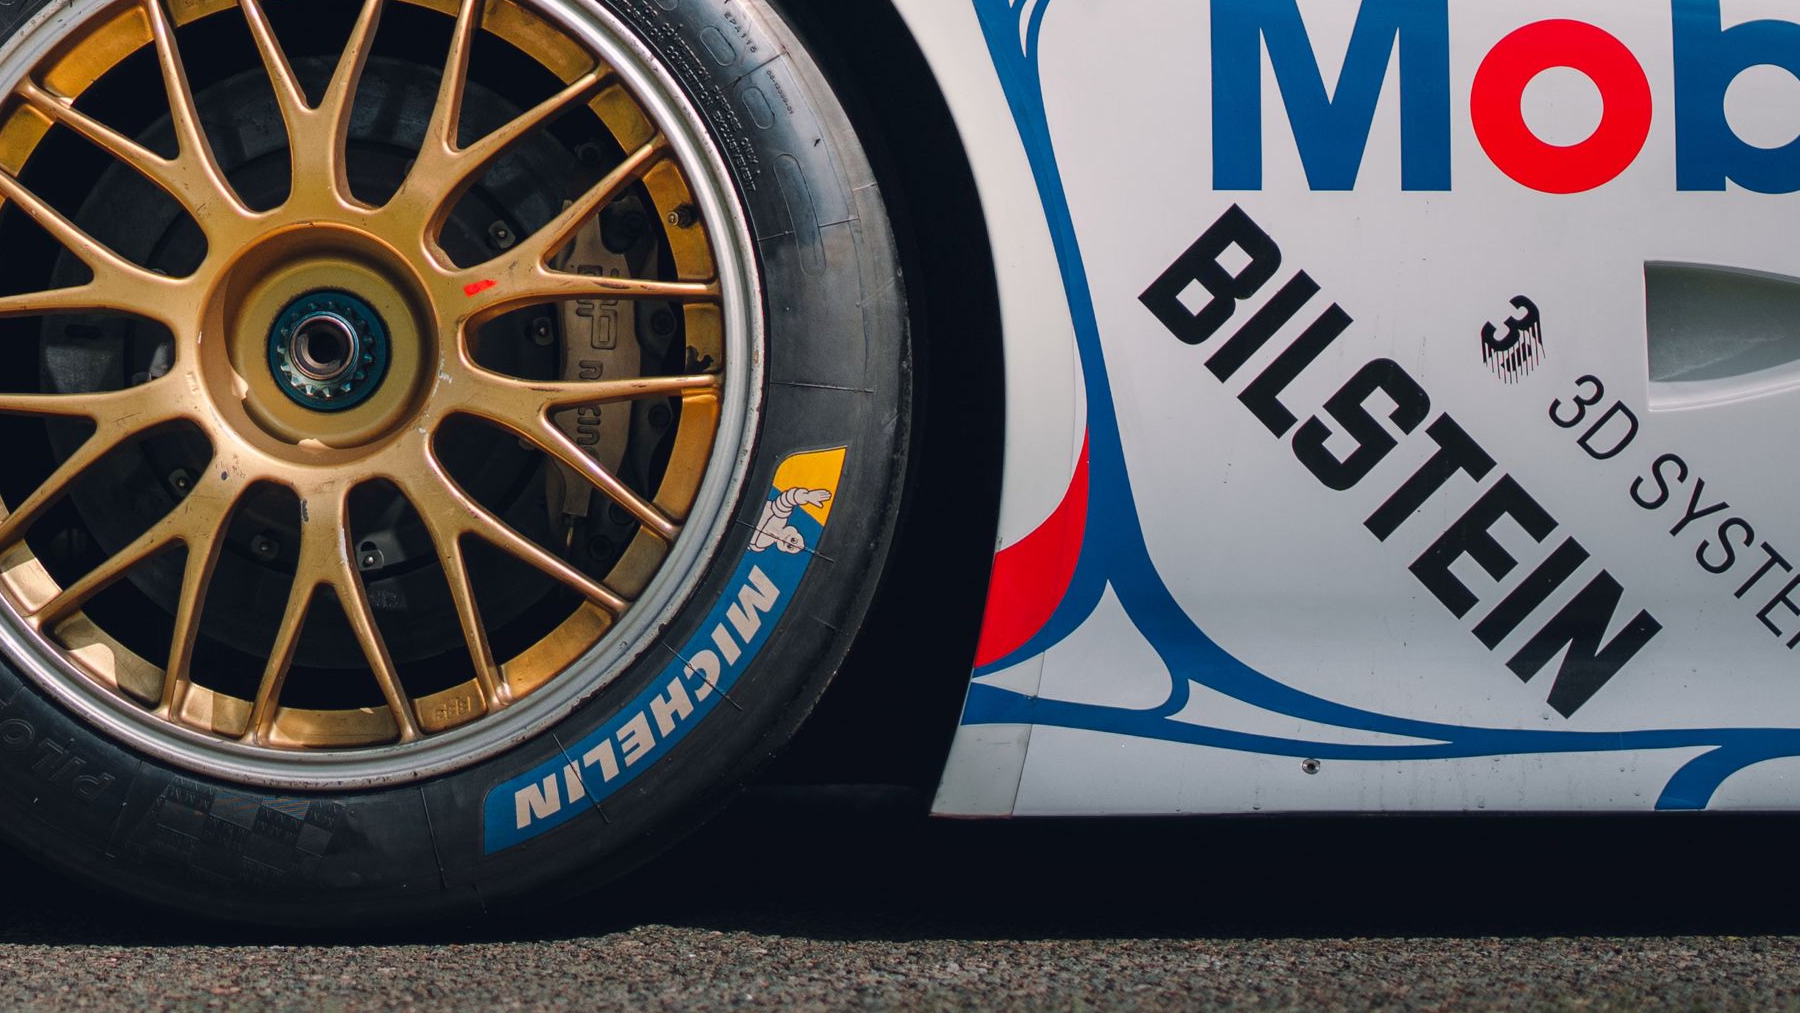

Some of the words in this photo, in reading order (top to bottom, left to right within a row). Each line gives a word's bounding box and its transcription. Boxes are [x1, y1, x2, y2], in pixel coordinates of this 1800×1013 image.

[1137, 203, 1663, 719] BILSTEIN
[1549, 374, 1639, 460] 3D
[1630, 453, 1800, 650] SYSTE
[514, 565, 781, 830] MICHELIN
